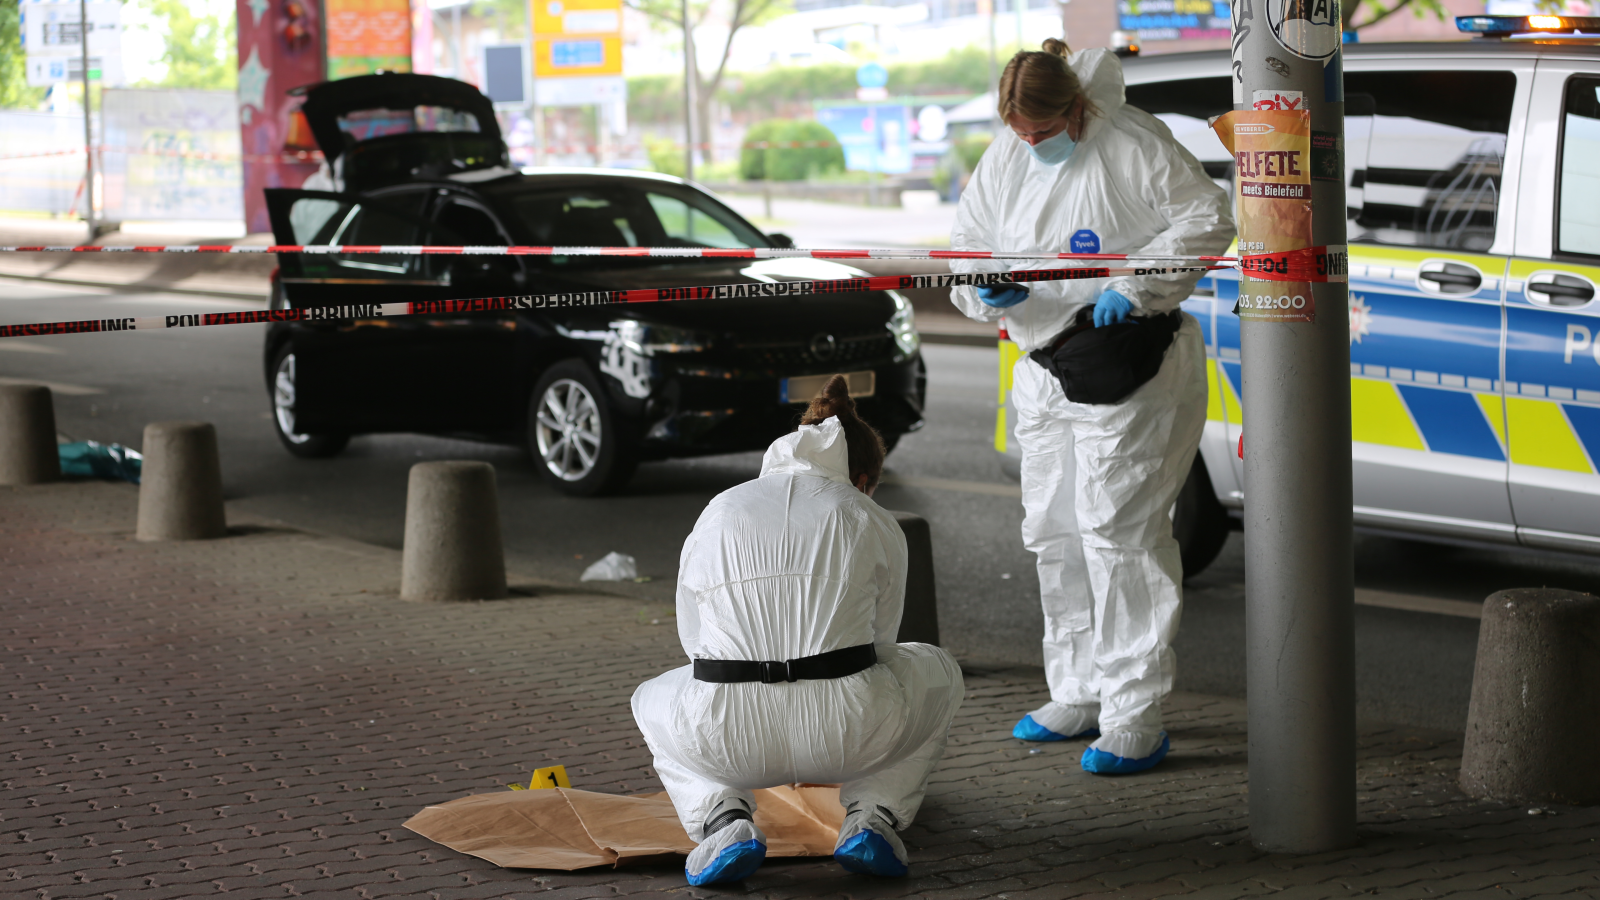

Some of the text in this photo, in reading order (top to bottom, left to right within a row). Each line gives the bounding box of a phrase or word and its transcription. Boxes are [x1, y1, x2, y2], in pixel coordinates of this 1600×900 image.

[1242, 184, 1304, 197] meets Bielefeld
[1075, 240, 1096, 250] Tyvek
[1248, 241, 1255, 250] PC
[1256, 241, 1264, 250] 69
[1255, 294, 1306, 310] 22:00
[1564, 323, 1600, 367] P
[547, 772, 559, 787] 1
